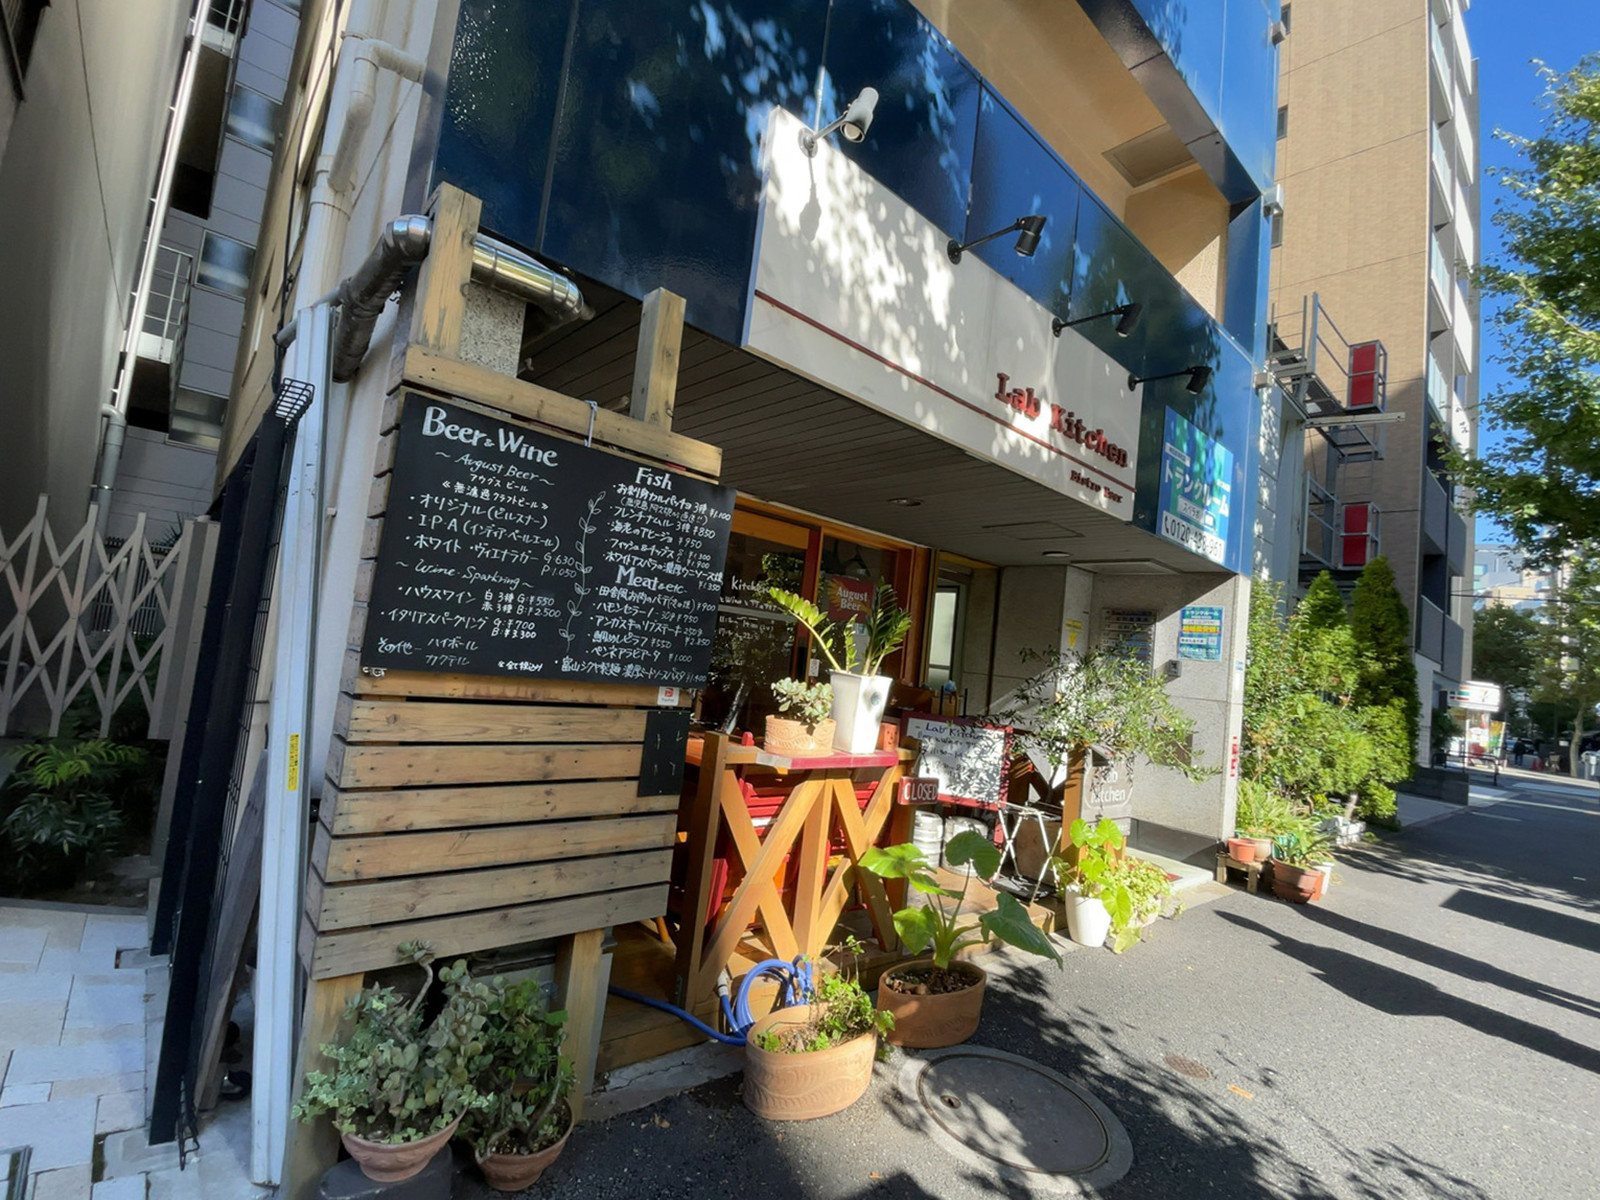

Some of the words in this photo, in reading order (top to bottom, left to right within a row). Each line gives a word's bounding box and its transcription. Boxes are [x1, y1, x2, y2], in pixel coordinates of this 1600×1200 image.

[422, 406, 486, 446] Beer
[498, 428, 559, 467] Wine
[635, 466, 672, 491] Fish
[1165, 459, 1229, 517] トランクルーム
[615, 564, 660, 592] Meat
[404, 584, 476, 605] ハウスワイン
[836, 586, 868, 602] August
[840, 598, 861, 611] Beer
[378, 636, 413, 656] その他
[427, 635, 479, 652] ハイボール
[425, 653, 470, 668] カクテル
[903, 781, 938, 802] CLOSED
